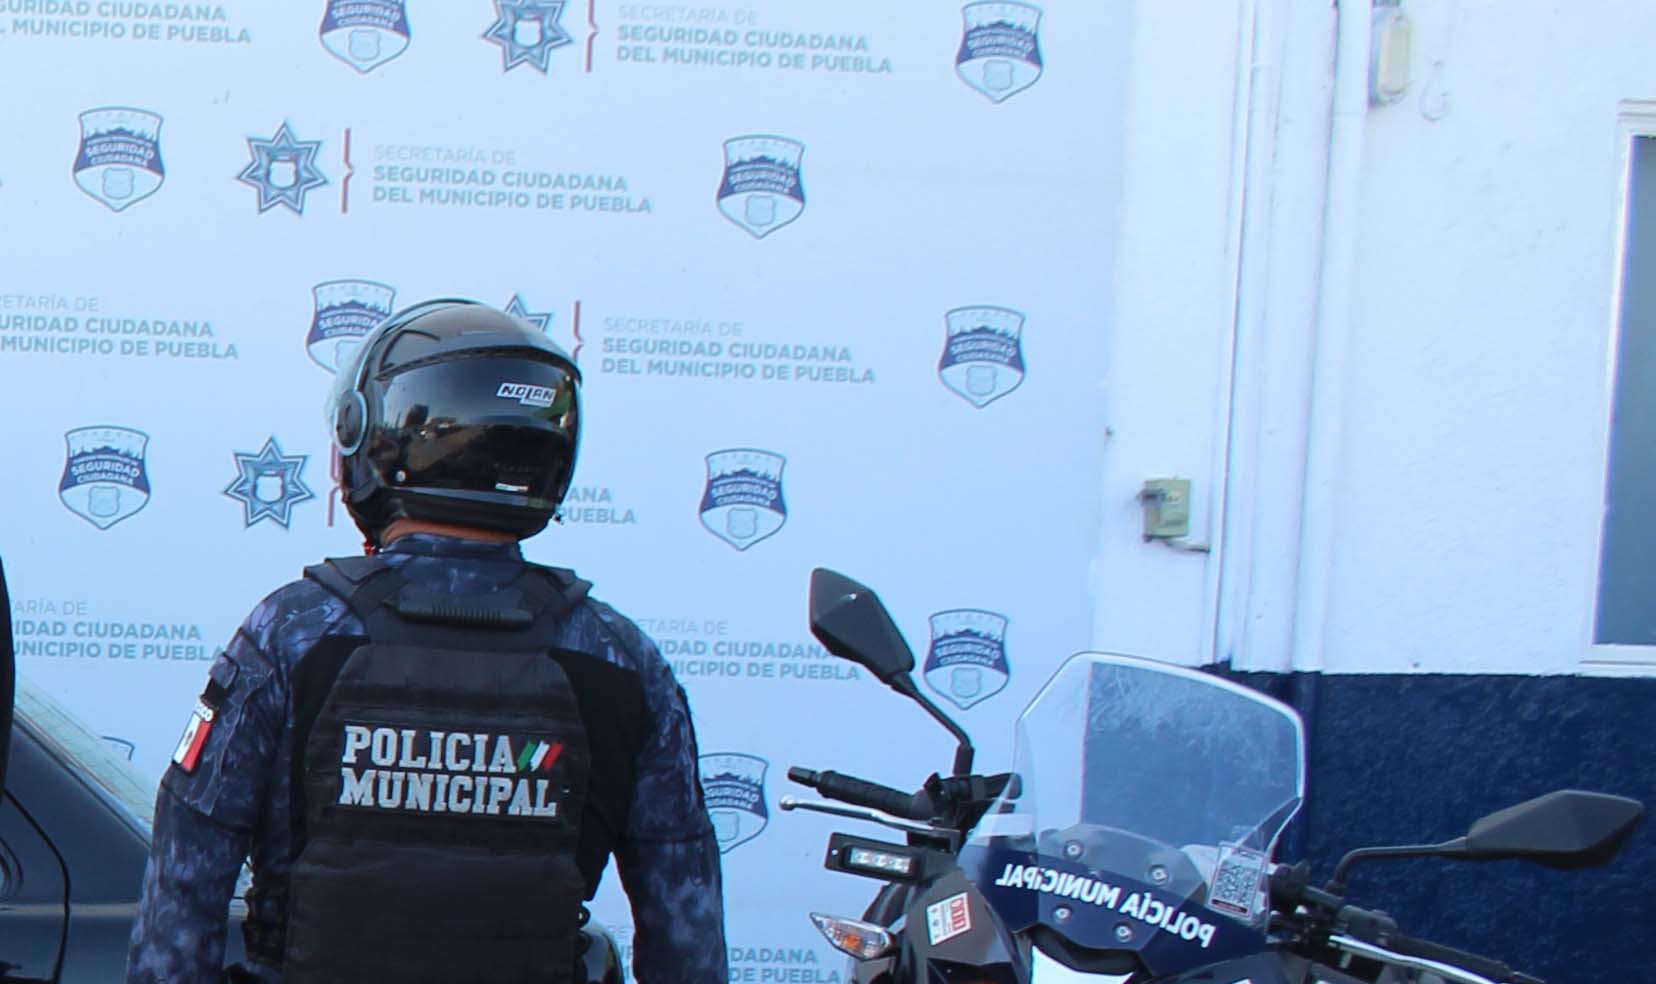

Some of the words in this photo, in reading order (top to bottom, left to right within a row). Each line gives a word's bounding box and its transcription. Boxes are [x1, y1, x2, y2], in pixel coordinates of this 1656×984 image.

[97, 2, 226, 21] CIUDADANA
[12, 19, 125, 38] MUNICIPIO
[133, 23, 161, 40] DE
[168, 25, 252, 42] PUEBLA
[619, 25, 738, 45] SEGURIDAD
[745, 31, 869, 51] CIUDADANA
[618, 46, 656, 62] DEL
[663, 48, 771, 67] MUNICIPIO
[779, 52, 806, 69] DE
[812, 55, 893, 73] PUEBLA
[375, 165, 495, 185] SEGURIDAD
[503, 171, 628, 191] CIUDADANA
[374, 186, 413, 203] DEL
[419, 189, 529, 207] MUNICIPIO
[537, 192, 564, 210] DE
[571, 195, 653, 213] PUEBLA
[86, 318, 214, 337] CIUDADANA
[0, 336, 113, 354] MUNICIPIO
[121, 339, 149, 356] DE
[155, 341, 239, 358] PUEBLA
[604, 337, 722, 357] SEGURIDAD
[729, 343, 852, 362] CIUDADANA
[603, 358, 641, 375] DEL
[647, 360, 755, 378] MUNICIPIO
[763, 363, 789, 380] DE
[796, 366, 876, 383] PUEBLA
[500, 383, 556, 407] NOLAN
[73, 621, 202, 640] CIUDADANA
[107, 644, 137, 659] DE
[746, 662, 776, 678] DE
[780, 664, 861, 681] PUEBLA
[341, 725, 519, 773] POLICIA
[338, 766, 558, 818] MUNICIPAL
[728, 967, 755, 982] DE
[761, 968, 841, 984] PUEBLA
